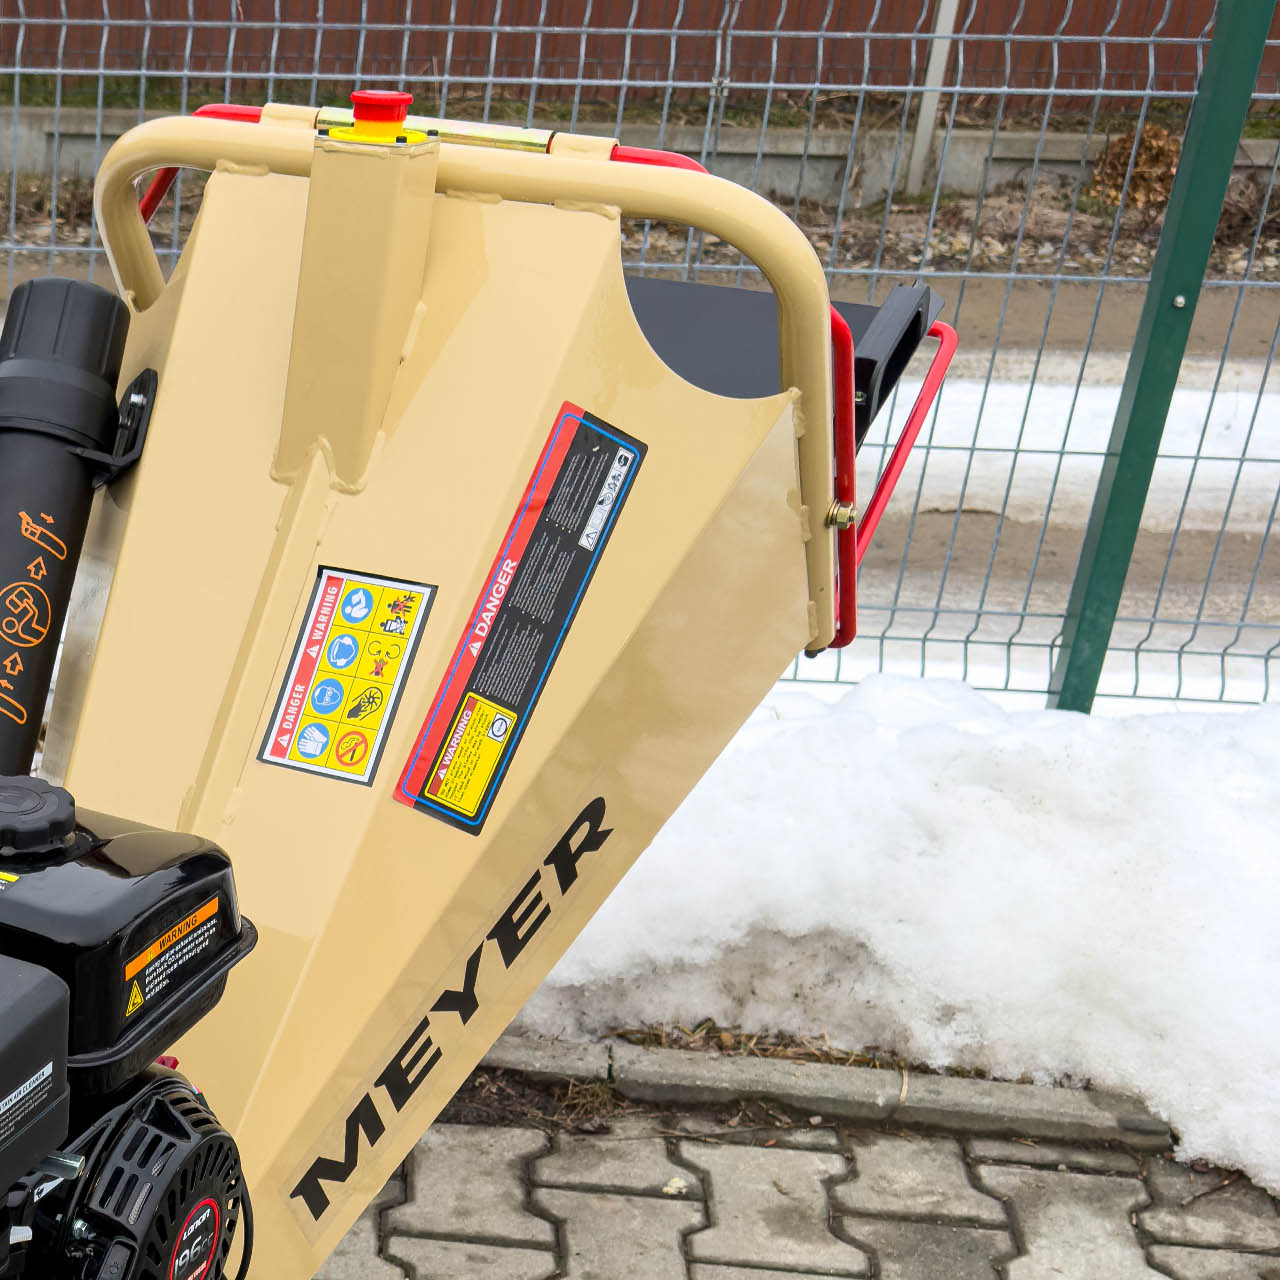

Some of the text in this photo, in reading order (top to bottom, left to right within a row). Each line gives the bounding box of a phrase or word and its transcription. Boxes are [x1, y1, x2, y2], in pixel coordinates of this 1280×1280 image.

[312, 586, 338, 640] WARNING
[475, 559, 517, 637] DANGER
[282, 684, 306, 729] DANGER
[442, 710, 472, 765] WARNING
[159, 915, 198, 950] WARNING
[290, 796, 614, 1221] MEYER
